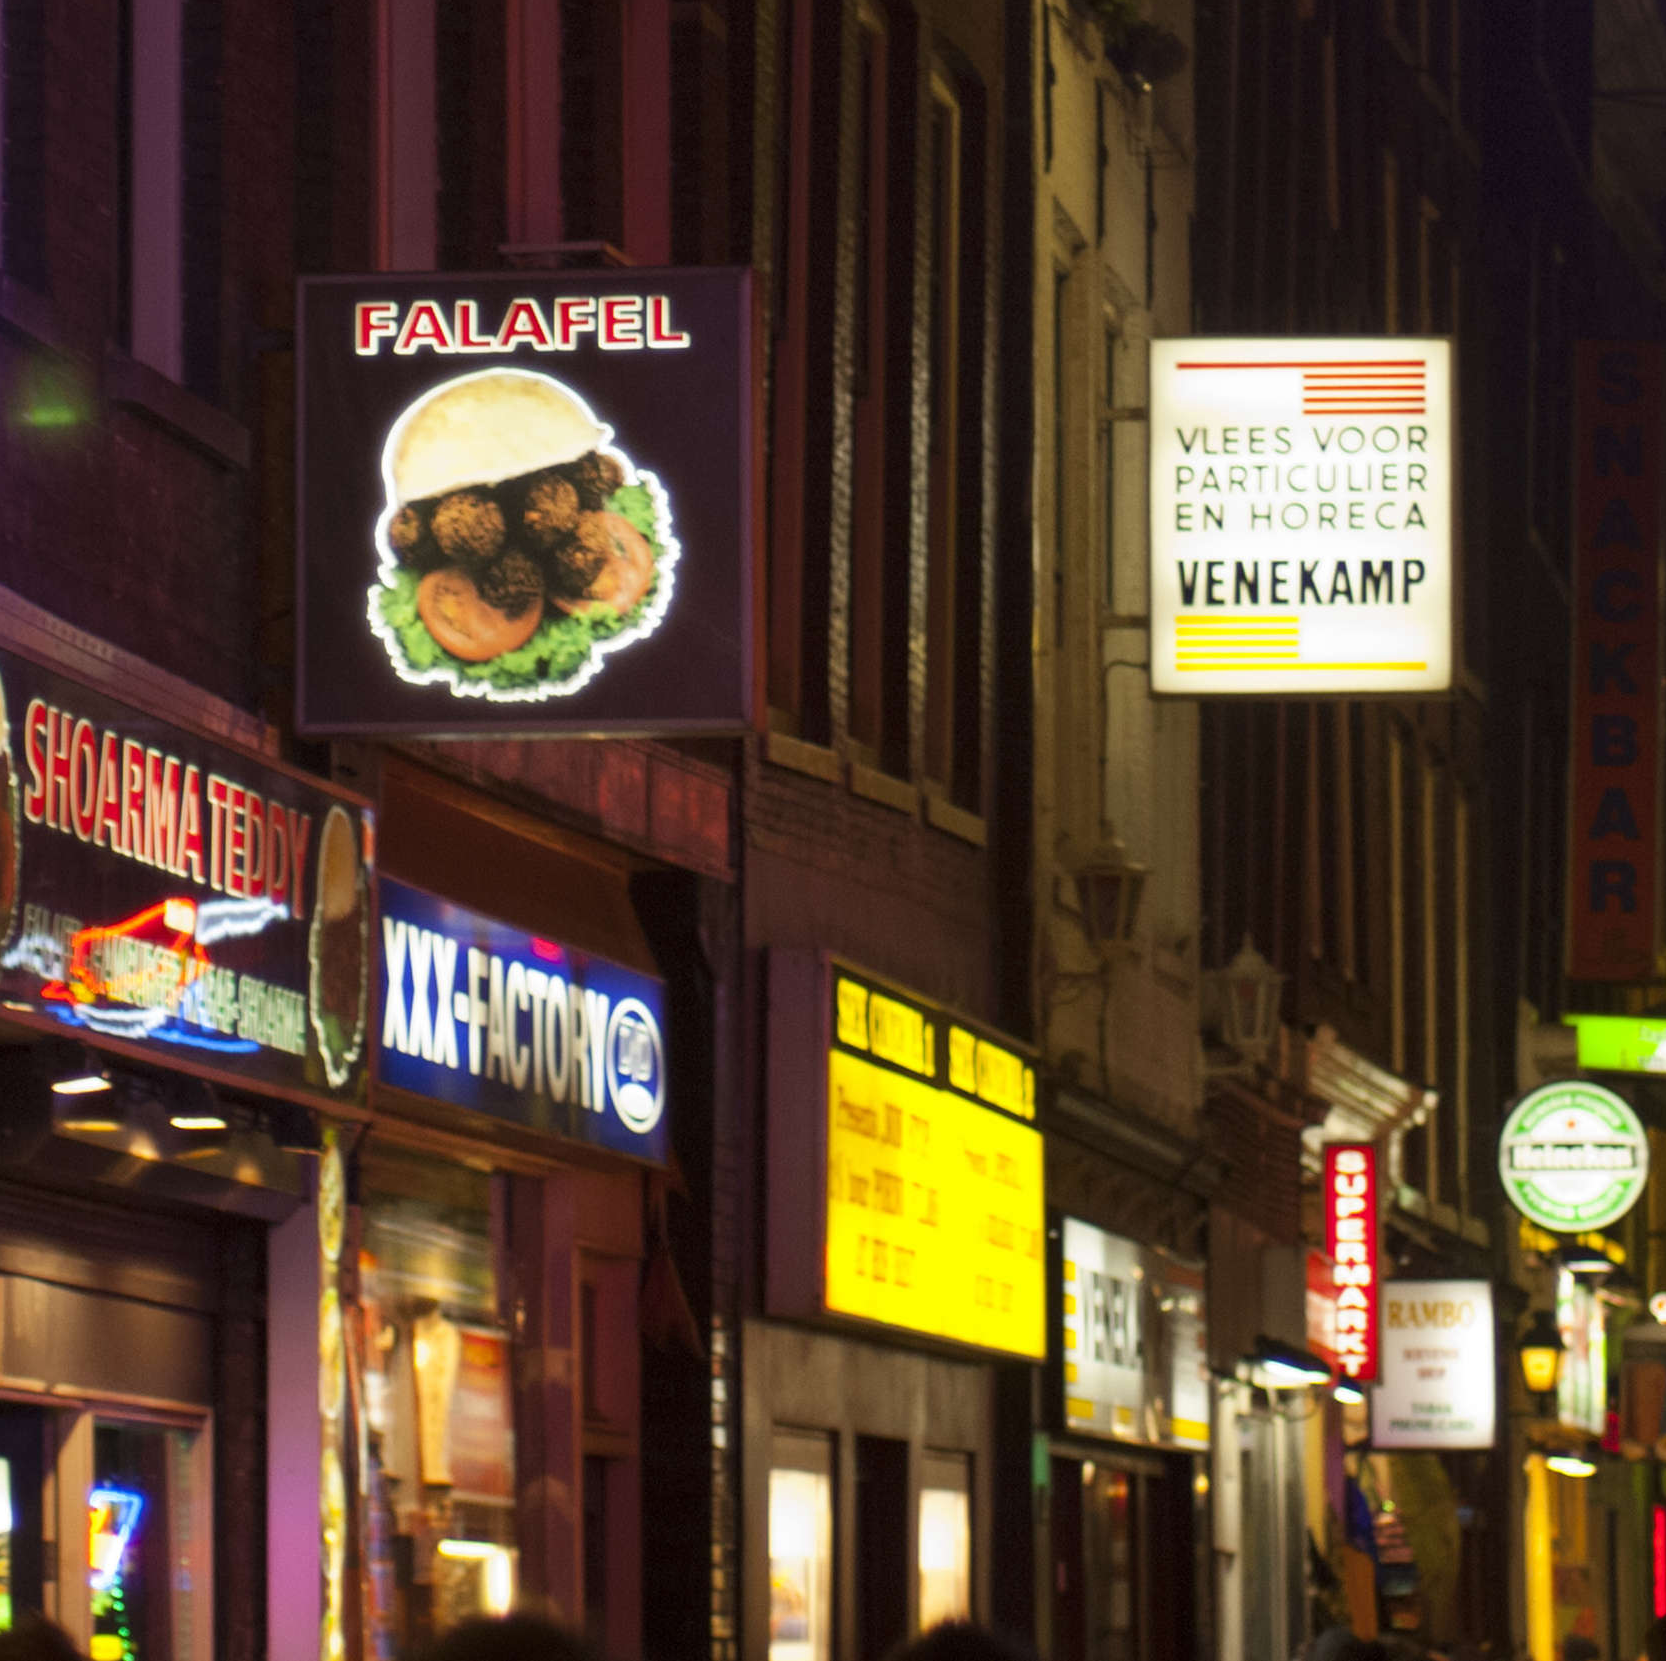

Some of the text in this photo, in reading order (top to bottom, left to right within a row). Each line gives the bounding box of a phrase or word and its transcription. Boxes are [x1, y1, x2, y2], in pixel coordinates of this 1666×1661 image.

[355, 295, 691, 356] FALAFEL
[1176, 425, 1429, 455] VLEES VOOR
[1175, 463, 1428, 495] PARTICULIER
[1175, 501, 1427, 532] EN HORECA
[1177, 559, 1426, 607] VENEKAMP
[24, 697, 312, 921] SHOARMA TEDDY
[382, 916, 610, 1114] XXX-FACTORY
[1333, 1150, 1371, 1377] SUPERMARKT
[1386, 1299, 1476, 1330] RAMBO
